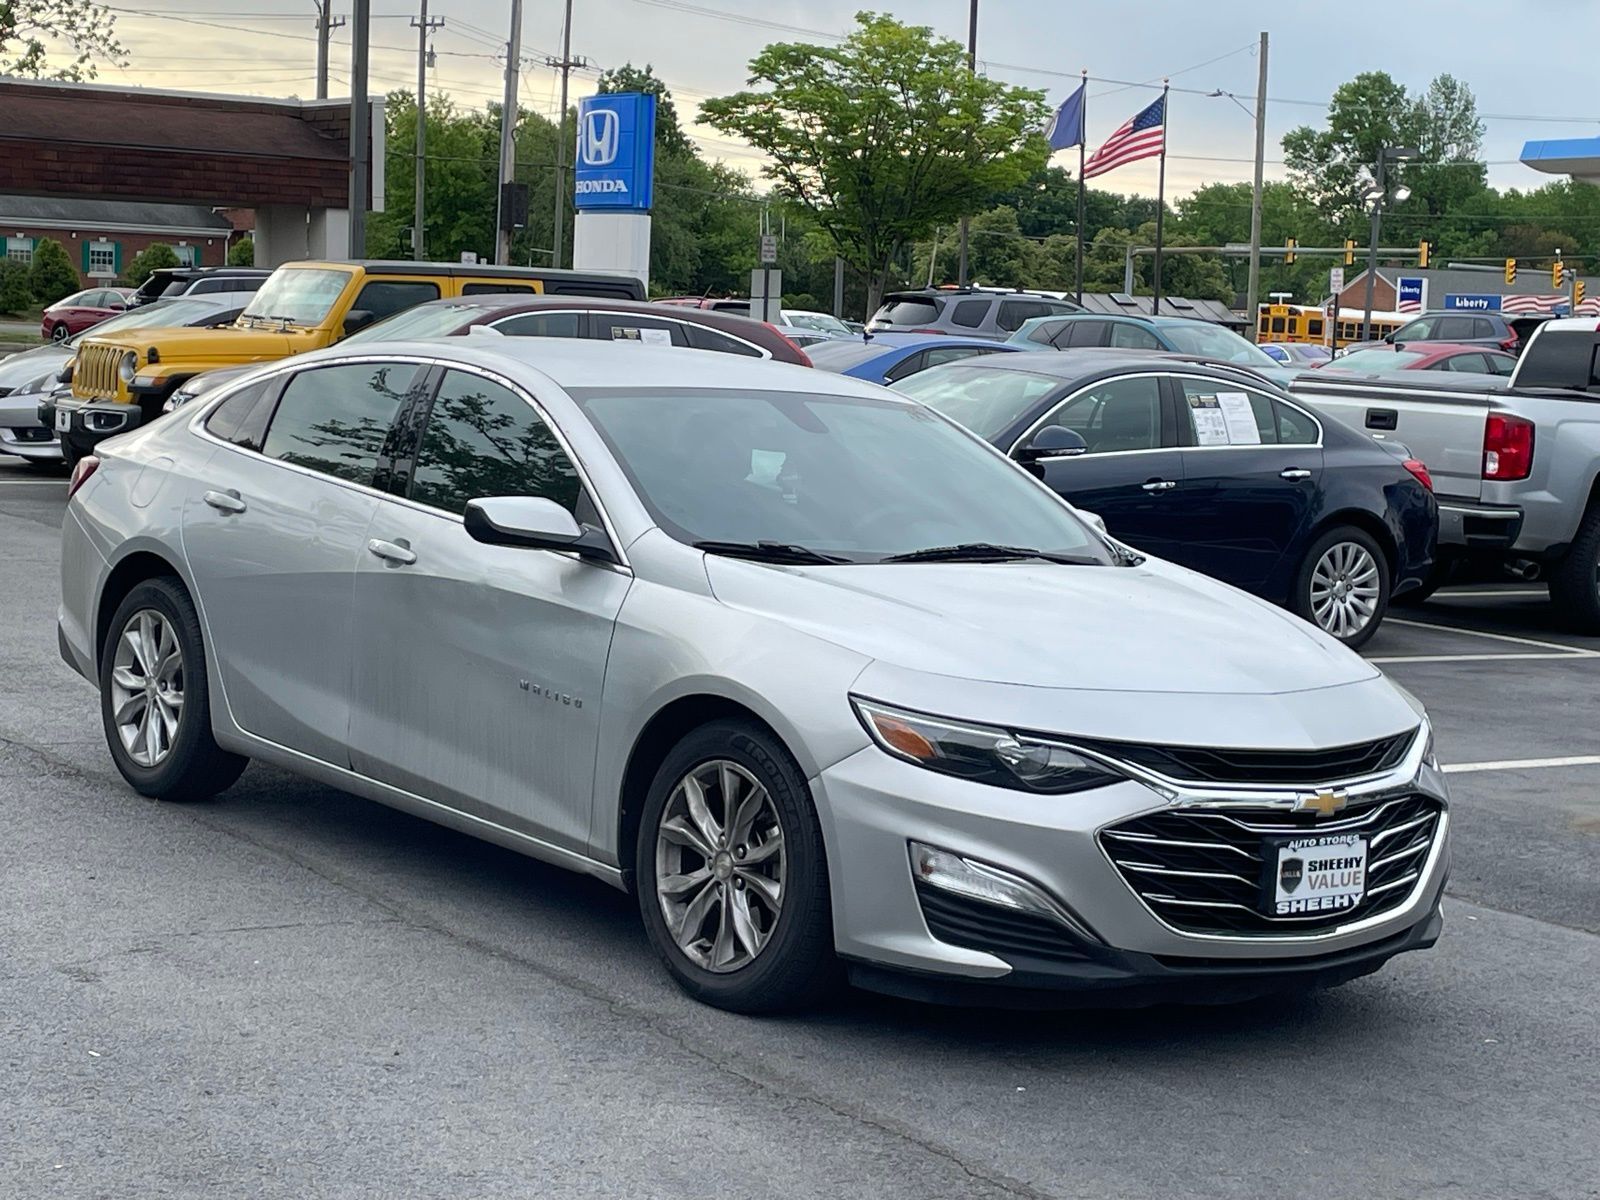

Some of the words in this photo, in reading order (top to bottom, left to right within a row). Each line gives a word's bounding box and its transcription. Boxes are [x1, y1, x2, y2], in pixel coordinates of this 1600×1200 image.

[576, 180, 628, 193] HONDA
[1455, 297, 1488, 309] Liberty
[1288, 839, 1316, 849] AUTO
[1319, 834, 1360, 845] STORES
[1308, 856, 1363, 872] SHEEHY
[1308, 871, 1362, 890] VALUE
[1276, 894, 1363, 914] SHEEHY
